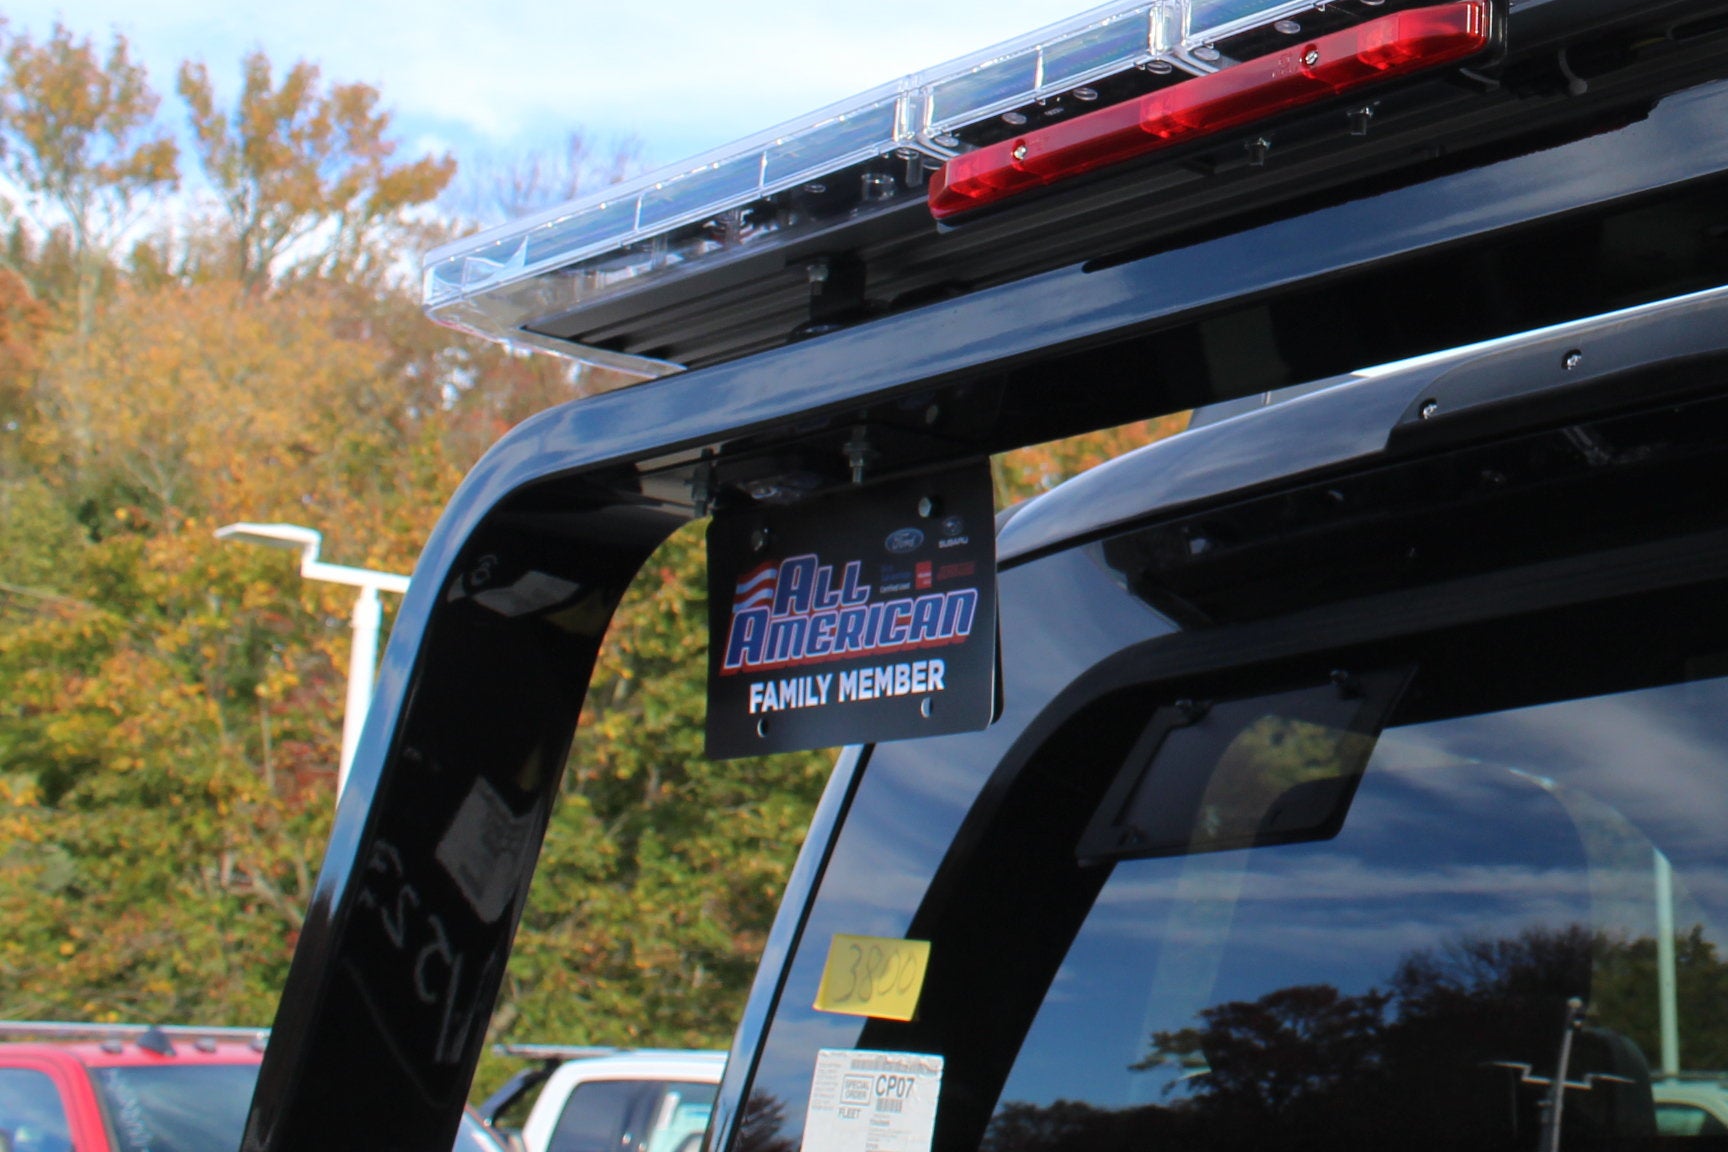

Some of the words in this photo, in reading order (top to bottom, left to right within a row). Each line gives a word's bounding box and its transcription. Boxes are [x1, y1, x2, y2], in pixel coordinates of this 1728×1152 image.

[748, 674, 832, 715] FAMILY
[838, 659, 946, 703] MEMBER
[875, 1074, 916, 1099] CP07
[837, 1108, 861, 1119] FLEET
